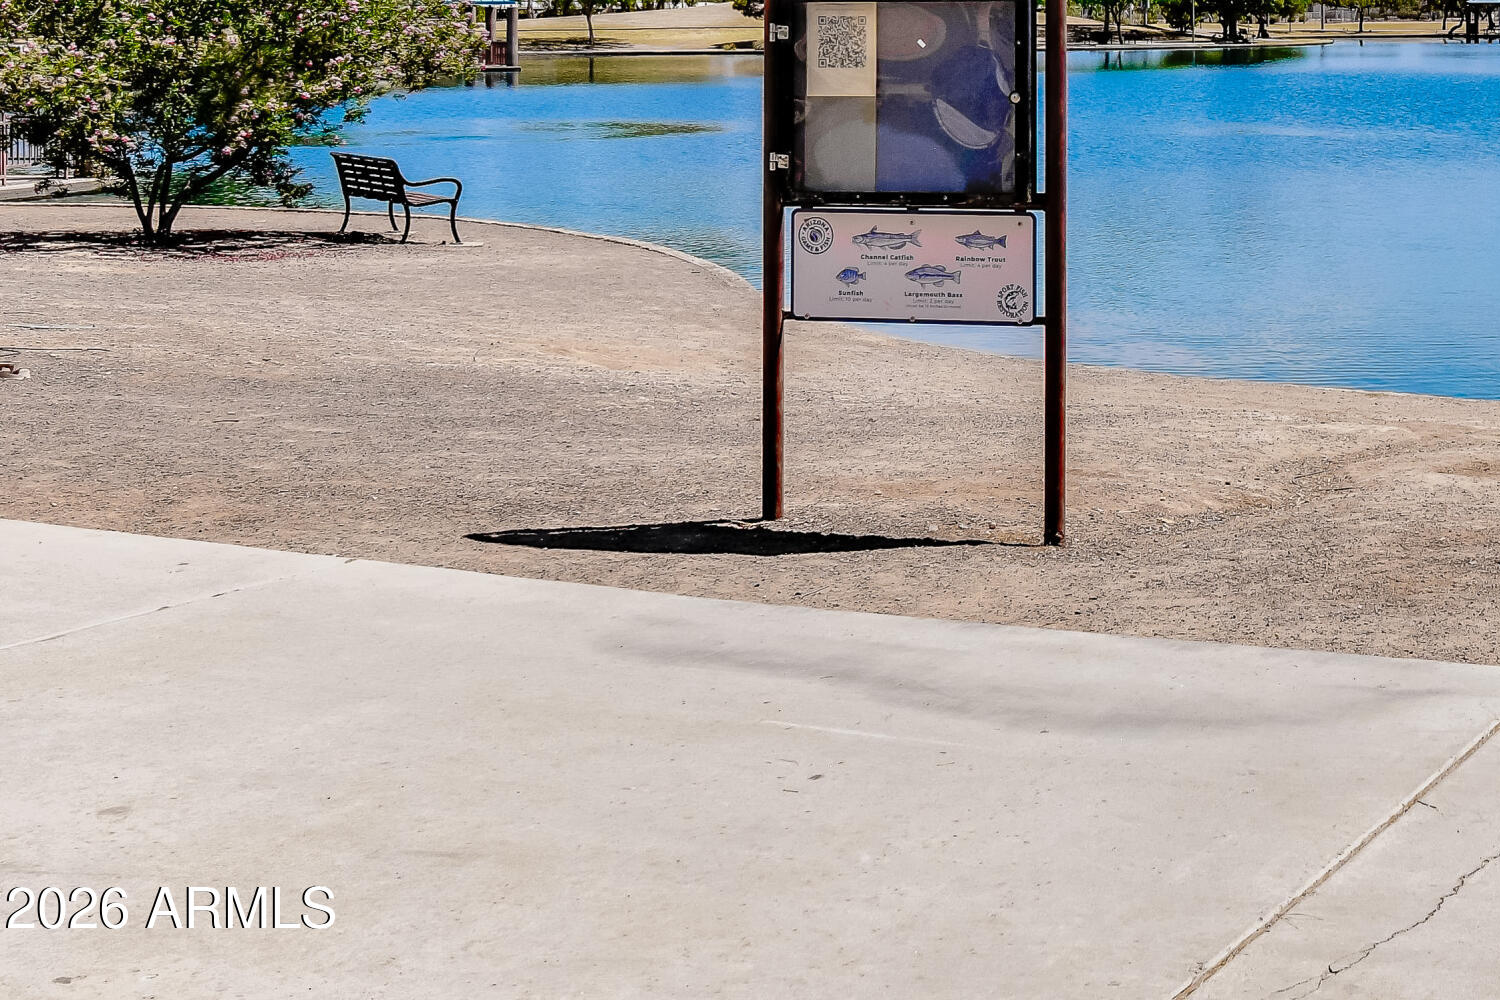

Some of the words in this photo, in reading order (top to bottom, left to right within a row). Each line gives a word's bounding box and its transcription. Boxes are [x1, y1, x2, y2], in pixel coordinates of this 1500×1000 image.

[802, 219, 830, 232] ARIZONA
[801, 236, 814, 252] GAME
[820, 236, 831, 251] FISH
[998, 283, 1014, 299] SPORT
[1015, 284, 1029, 298] FISH
[996, 300, 1029, 318] RESTORATION
